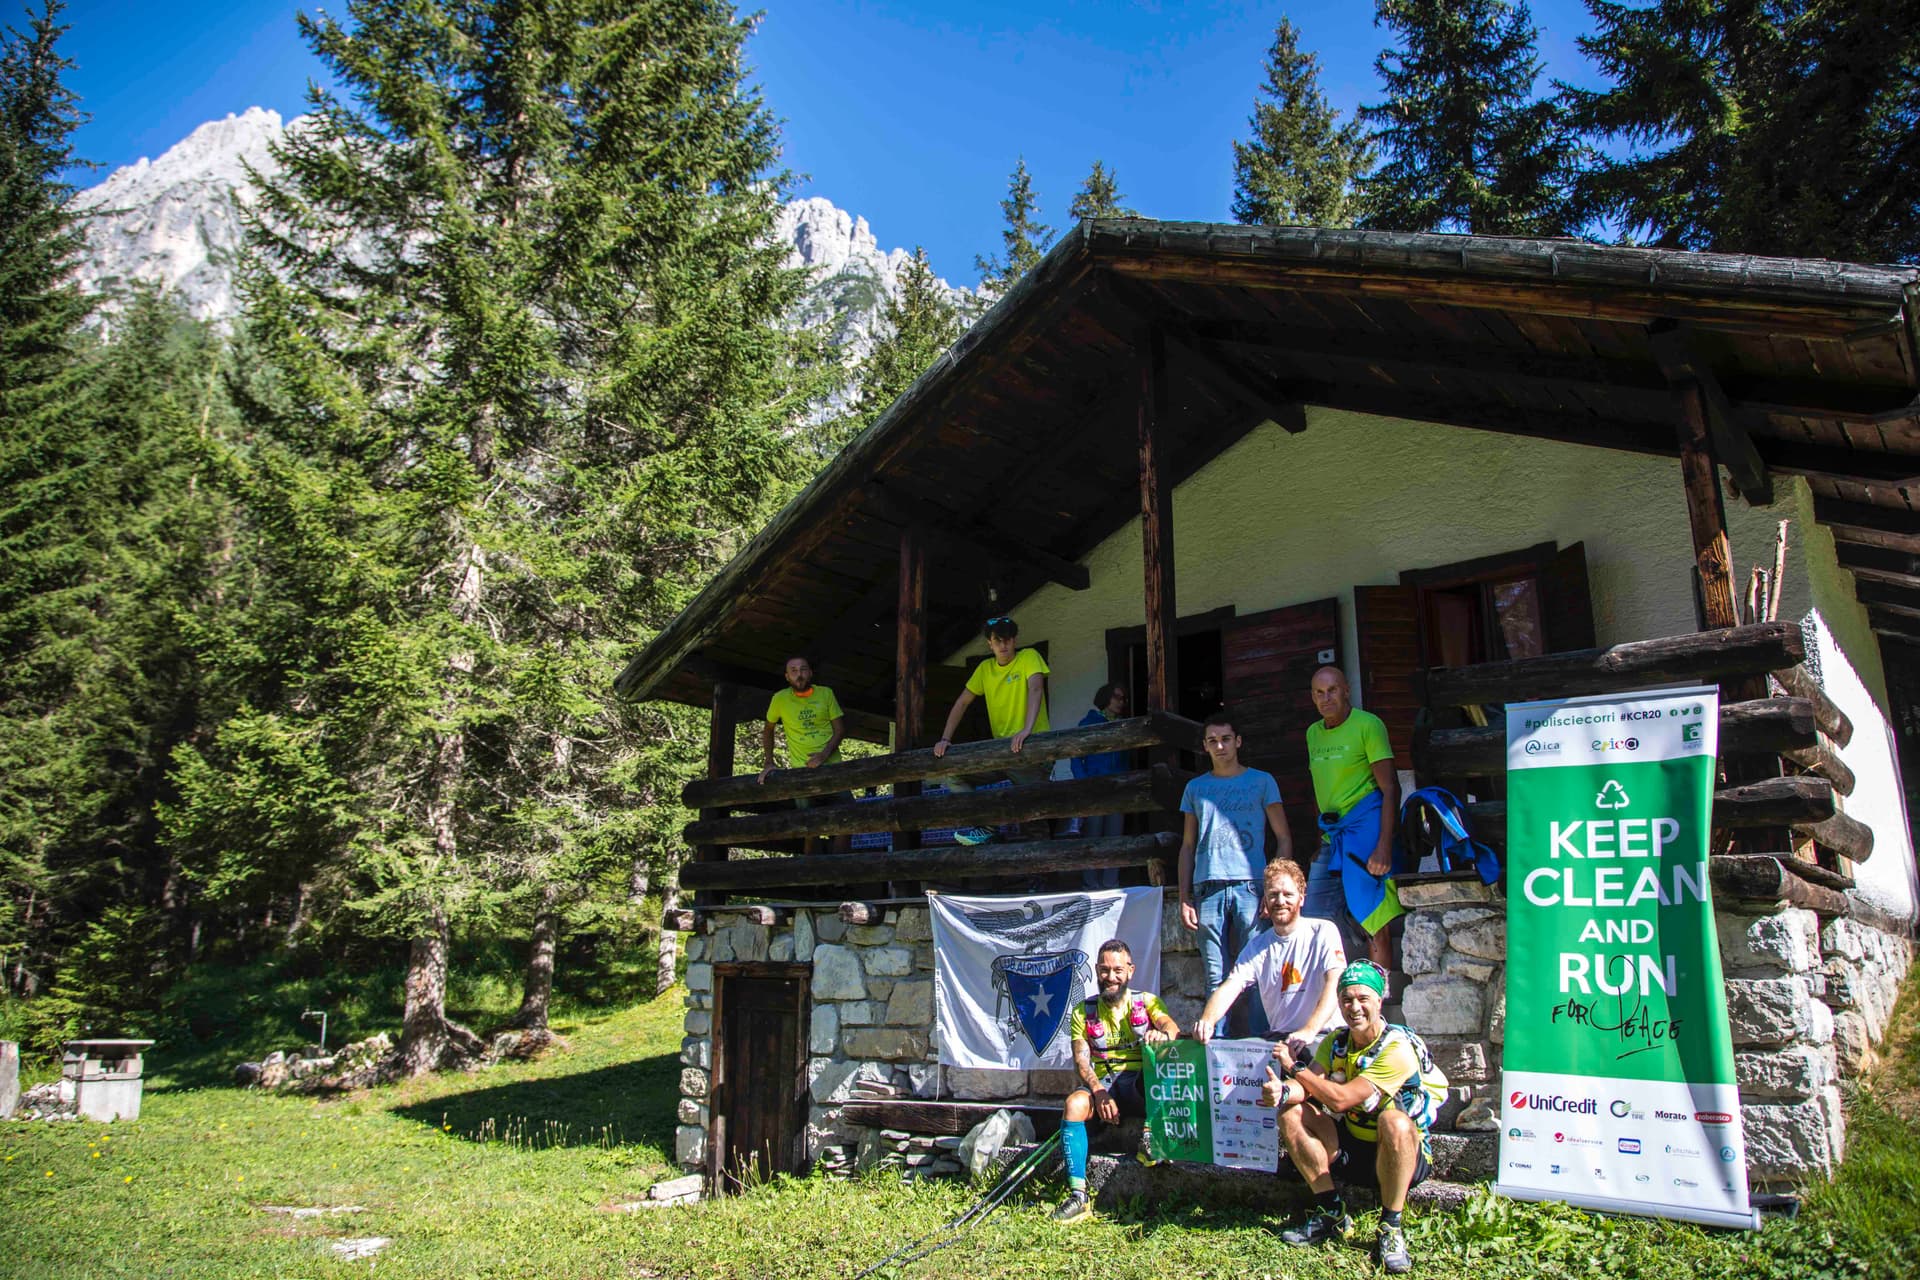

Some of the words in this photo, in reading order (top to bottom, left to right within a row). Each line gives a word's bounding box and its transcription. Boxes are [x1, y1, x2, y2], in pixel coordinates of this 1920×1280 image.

[1525, 711, 1616, 730] #pulisciecorri
[1620, 709, 1662, 722] #KCR20
[1549, 817, 1680, 859] KEEP
[1523, 861, 1708, 907] CLEAN
[1578, 918, 1654, 944] AND
[1016, 961, 1047, 975] ALPINO
[1048, 953, 1084, 974] ITALIANO
[1559, 952, 1677, 997] RUN
[1155, 1062, 1195, 1079] KEEP
[1150, 1084, 1205, 1102] CLEAN
[1168, 1107, 1191, 1117] AND
[1529, 1093, 1598, 1115] UniCredit
[1654, 1110, 1688, 1121] Morato
[1164, 1121, 1198, 1139] RUN
